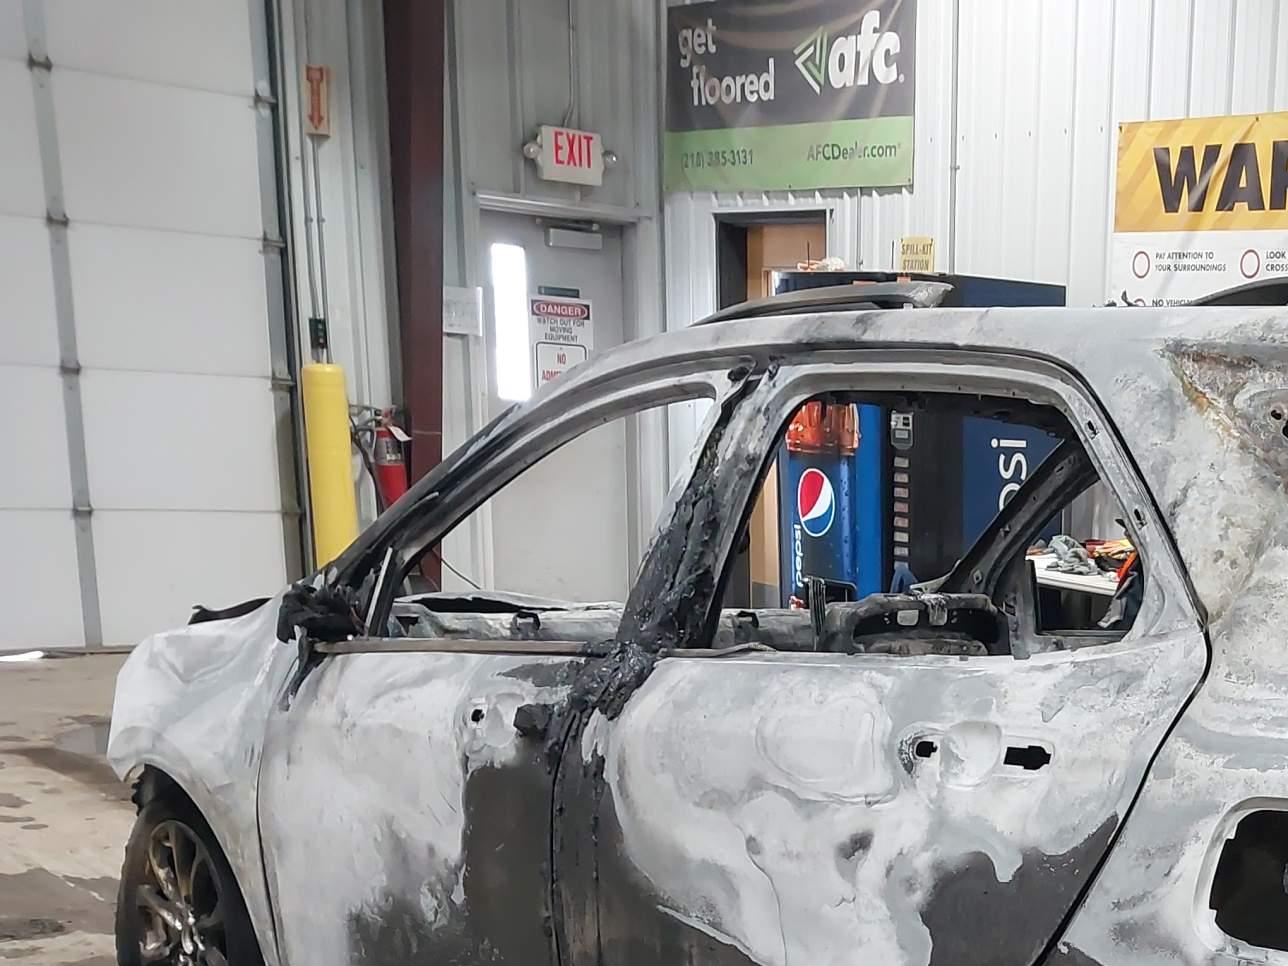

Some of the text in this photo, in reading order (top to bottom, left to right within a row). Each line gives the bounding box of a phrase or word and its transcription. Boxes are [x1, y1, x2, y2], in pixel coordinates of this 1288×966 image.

[678, 18, 717, 68] get
[691, 57, 775, 106] floored
[553, 131, 593, 169] EXIT
[807, 140, 898, 162] AFCDealr.com
[1167, 251, 1204, 260] ATTENTION
[1205, 251, 1214, 260] TO
[1266, 251, 1287, 259] LOOK
[1155, 263, 1227, 272] YOUR SURROUNDINGS
[1152, 298, 1165, 307] NO
[540, 303, 582, 317] DANGER
[559, 318, 571, 327] OUT
[572, 319, 585, 328] FOR
[549, 326, 573, 335] MOVING
[544, 332, 578, 342] EQUIPMENT
[556, 352, 567, 366] NO
